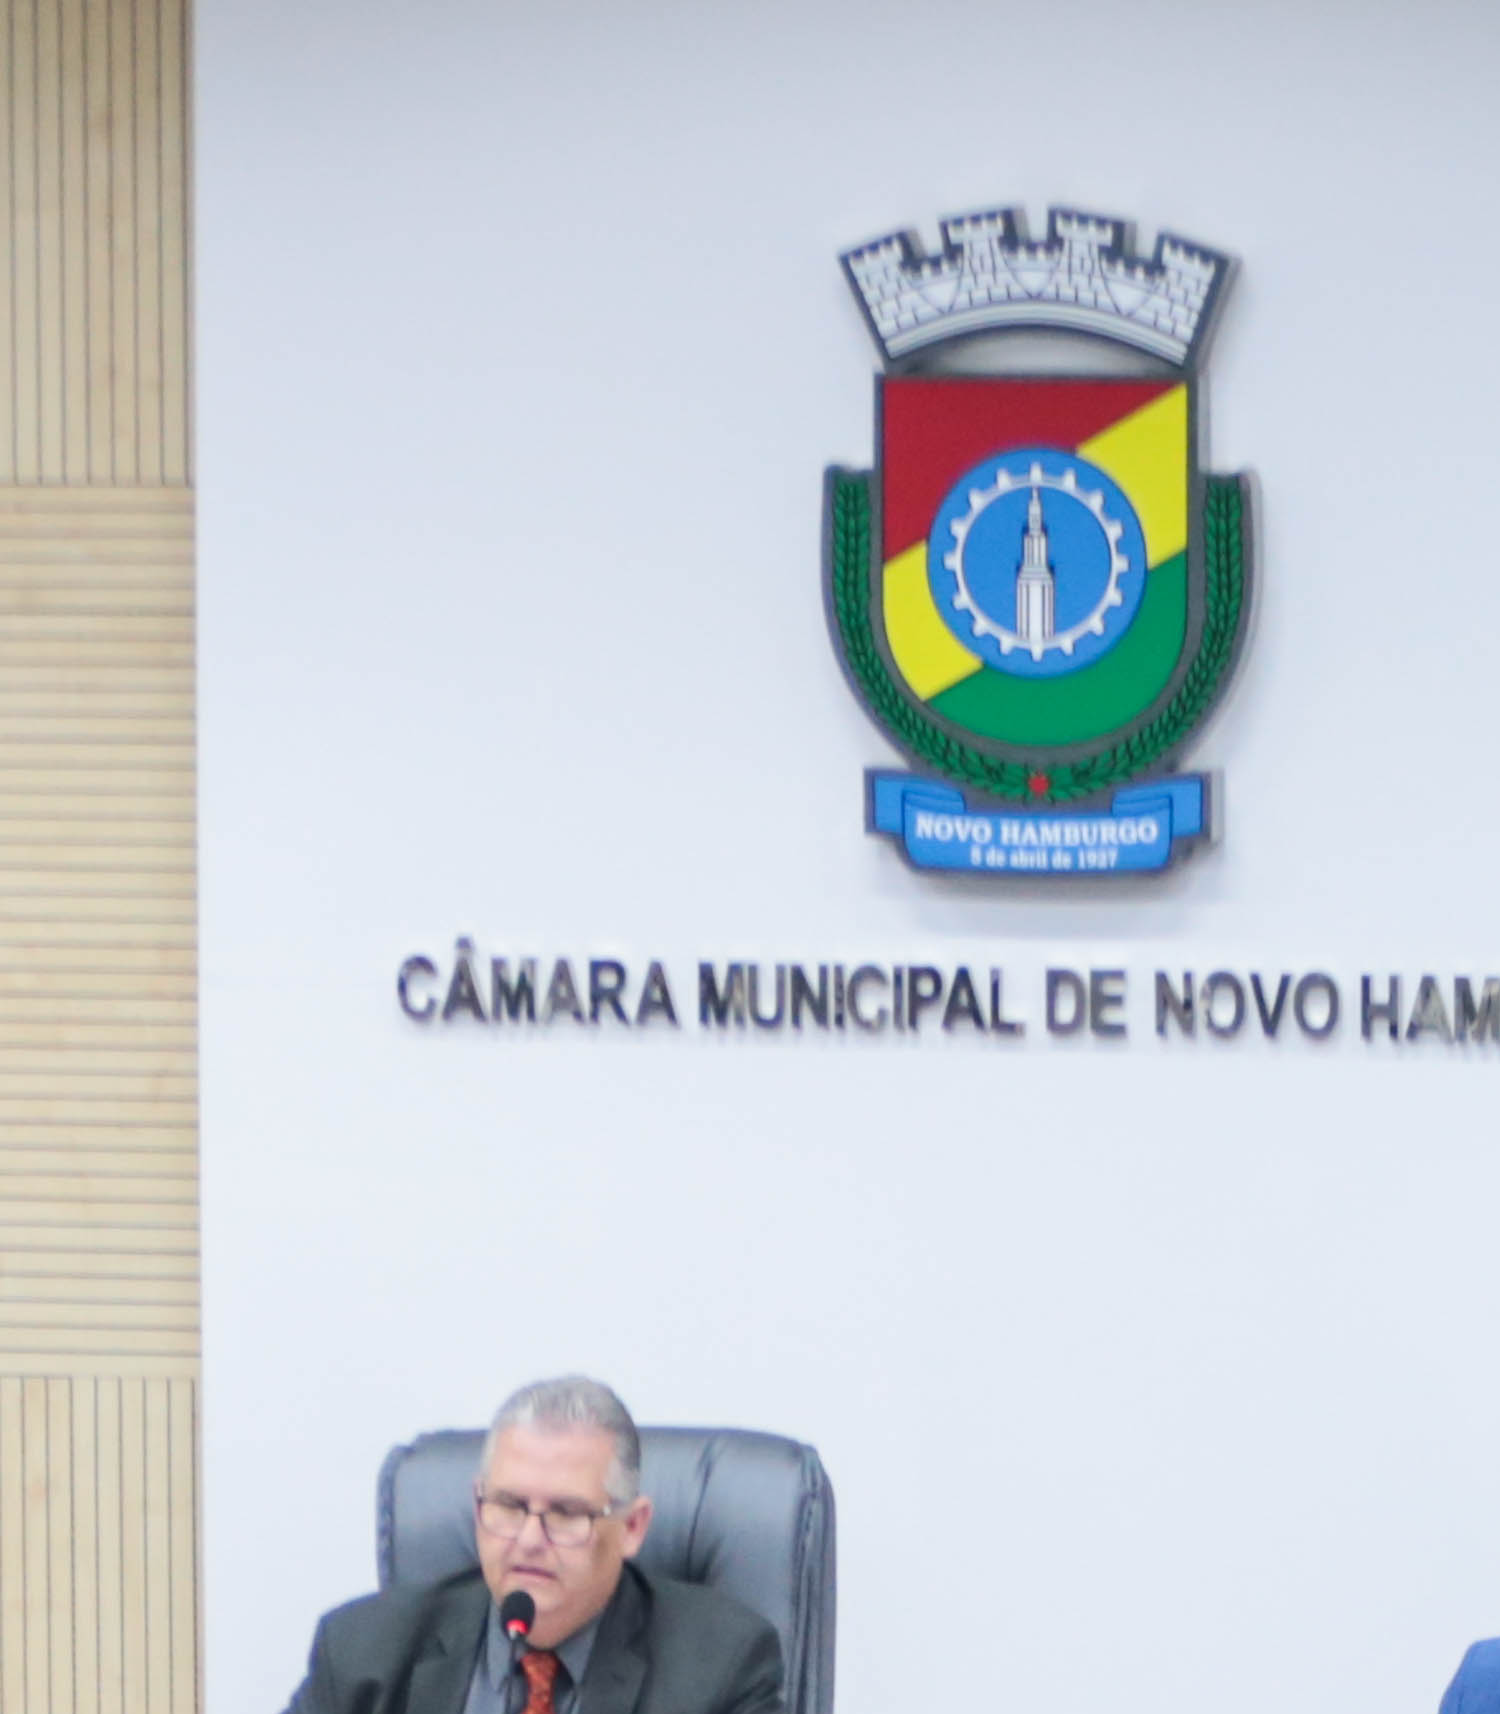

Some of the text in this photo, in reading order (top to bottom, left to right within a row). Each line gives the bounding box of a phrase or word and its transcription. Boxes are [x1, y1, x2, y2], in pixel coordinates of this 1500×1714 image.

[915, 811, 1159, 846] NOVO HAMBURGO
[398, 934, 679, 1028] CÂMARA
[696, 955, 1025, 1039] MUNICIPAL
[1043, 966, 1127, 1041] DE
[1153, 970, 1342, 1046] NOVO
